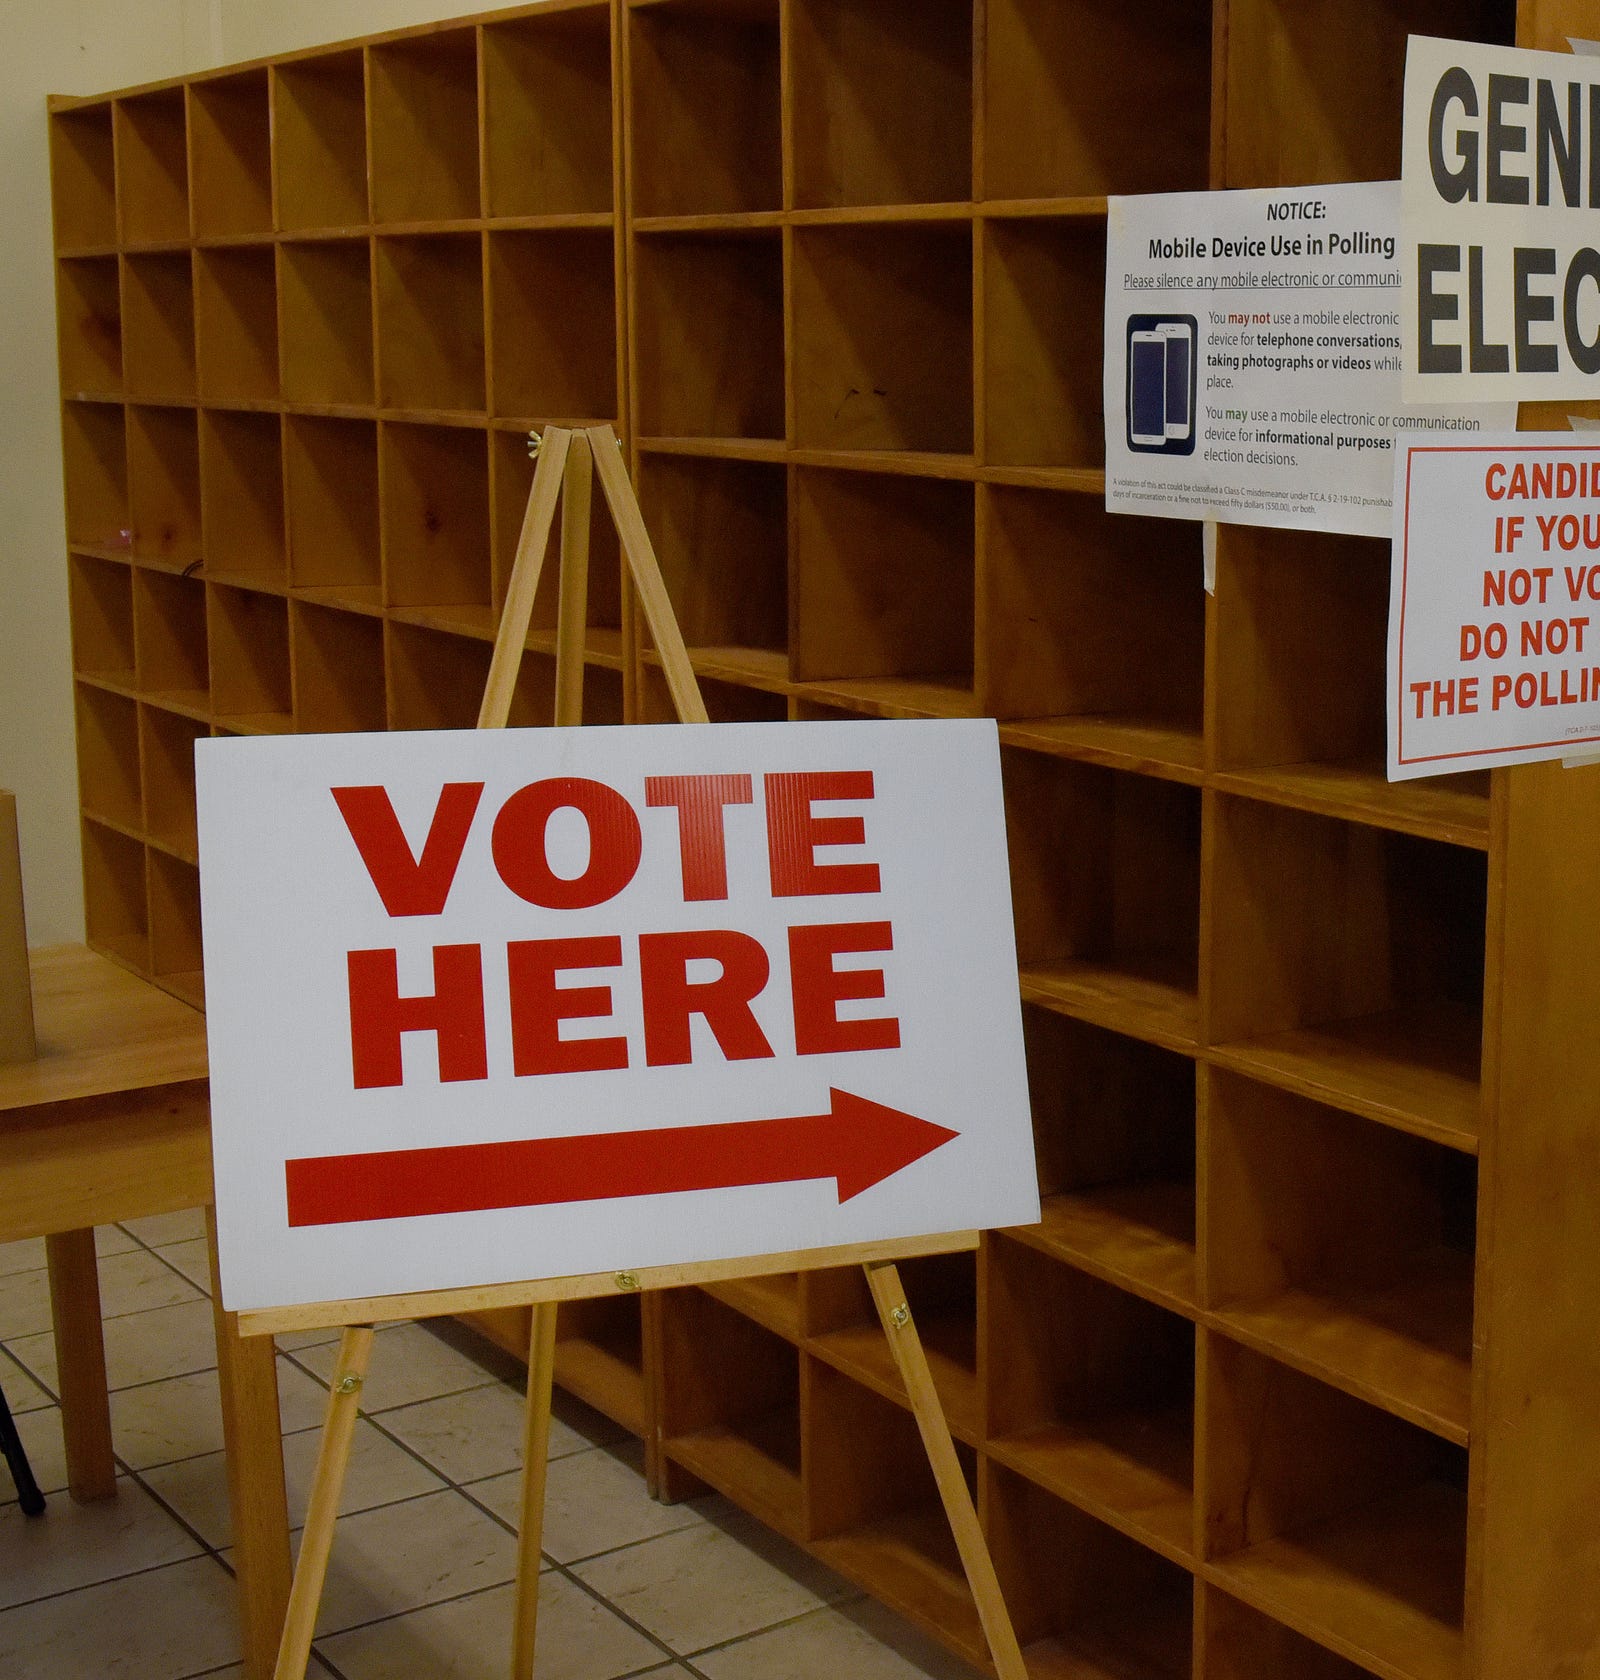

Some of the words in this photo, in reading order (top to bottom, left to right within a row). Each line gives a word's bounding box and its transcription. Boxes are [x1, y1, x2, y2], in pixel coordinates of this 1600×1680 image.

[1267, 201, 1326, 220] NOTICE:
[1149, 237, 1206, 259] Mobile
[1212, 236, 1266, 257] Device
[1271, 235, 1301, 256] Use
[1307, 234, 1323, 255] in
[1329, 232, 1395, 259] Polling
[1124, 273, 1154, 288] Please
[1156, 272, 1193, 288] silence
[1197, 275, 1218, 290] any
[1221, 271, 1258, 287] mobile
[1261, 271, 1318, 287] electronic
[1322, 274, 1335, 286] or
[1338, 269, 1401, 286] communi
[1209, 311, 1226, 324] You
[1228, 313, 1250, 327] may
[1252, 313, 1271, 324] not
[1273, 314, 1291, 325] use
[1294, 314, 1300, 325] a
[1302, 311, 1340, 325] mobile
[1343, 311, 1400, 325] electronic
[1208, 332, 1238, 346] device
[1240, 332, 1254, 345] for
[1257, 333, 1314, 349] telephone
[1207, 353, 1239, 371] taking
[1242, 354, 1314, 371] photographs
[1317, 358, 1329, 369] or
[1332, 356, 1371, 370] videos
[1206, 375, 1234, 391] place.
[1206, 406, 1223, 419] You
[1225, 410, 1248, 423] may
[1250, 410, 1269, 421] use
[1271, 411, 1277, 422] a
[1280, 409, 1318, 424] mobile
[1320, 409, 1375, 427] electronic
[1378, 415, 1390, 427] or
[1392, 416, 1480, 431] communication
[1204, 427, 1236, 441] device
[1238, 428, 1253, 442] for
[1255, 429, 1334, 446] informational
[1337, 436, 1391, 451] purposes
[1204, 448, 1243, 463] election
[1246, 450, 1298, 466] decisions.
[1167, 482, 1182, 491] could
[1183, 484, 1191, 492] be
[1192, 484, 1219, 494] classified
[1224, 486, 1240, 495] Class
[1246, 489, 1289, 499] misdemeanor
[1290, 491, 1308, 501] under
[1494, 516, 1524, 553] IF
[1483, 568, 1553, 607] NOT
[1460, 623, 1507, 662] DO
[1520, 617, 1590, 657] NOT
[1410, 677, 1479, 719] THE
[330, 771, 880, 917] VOTE
[348, 921, 901, 1089] HERE
